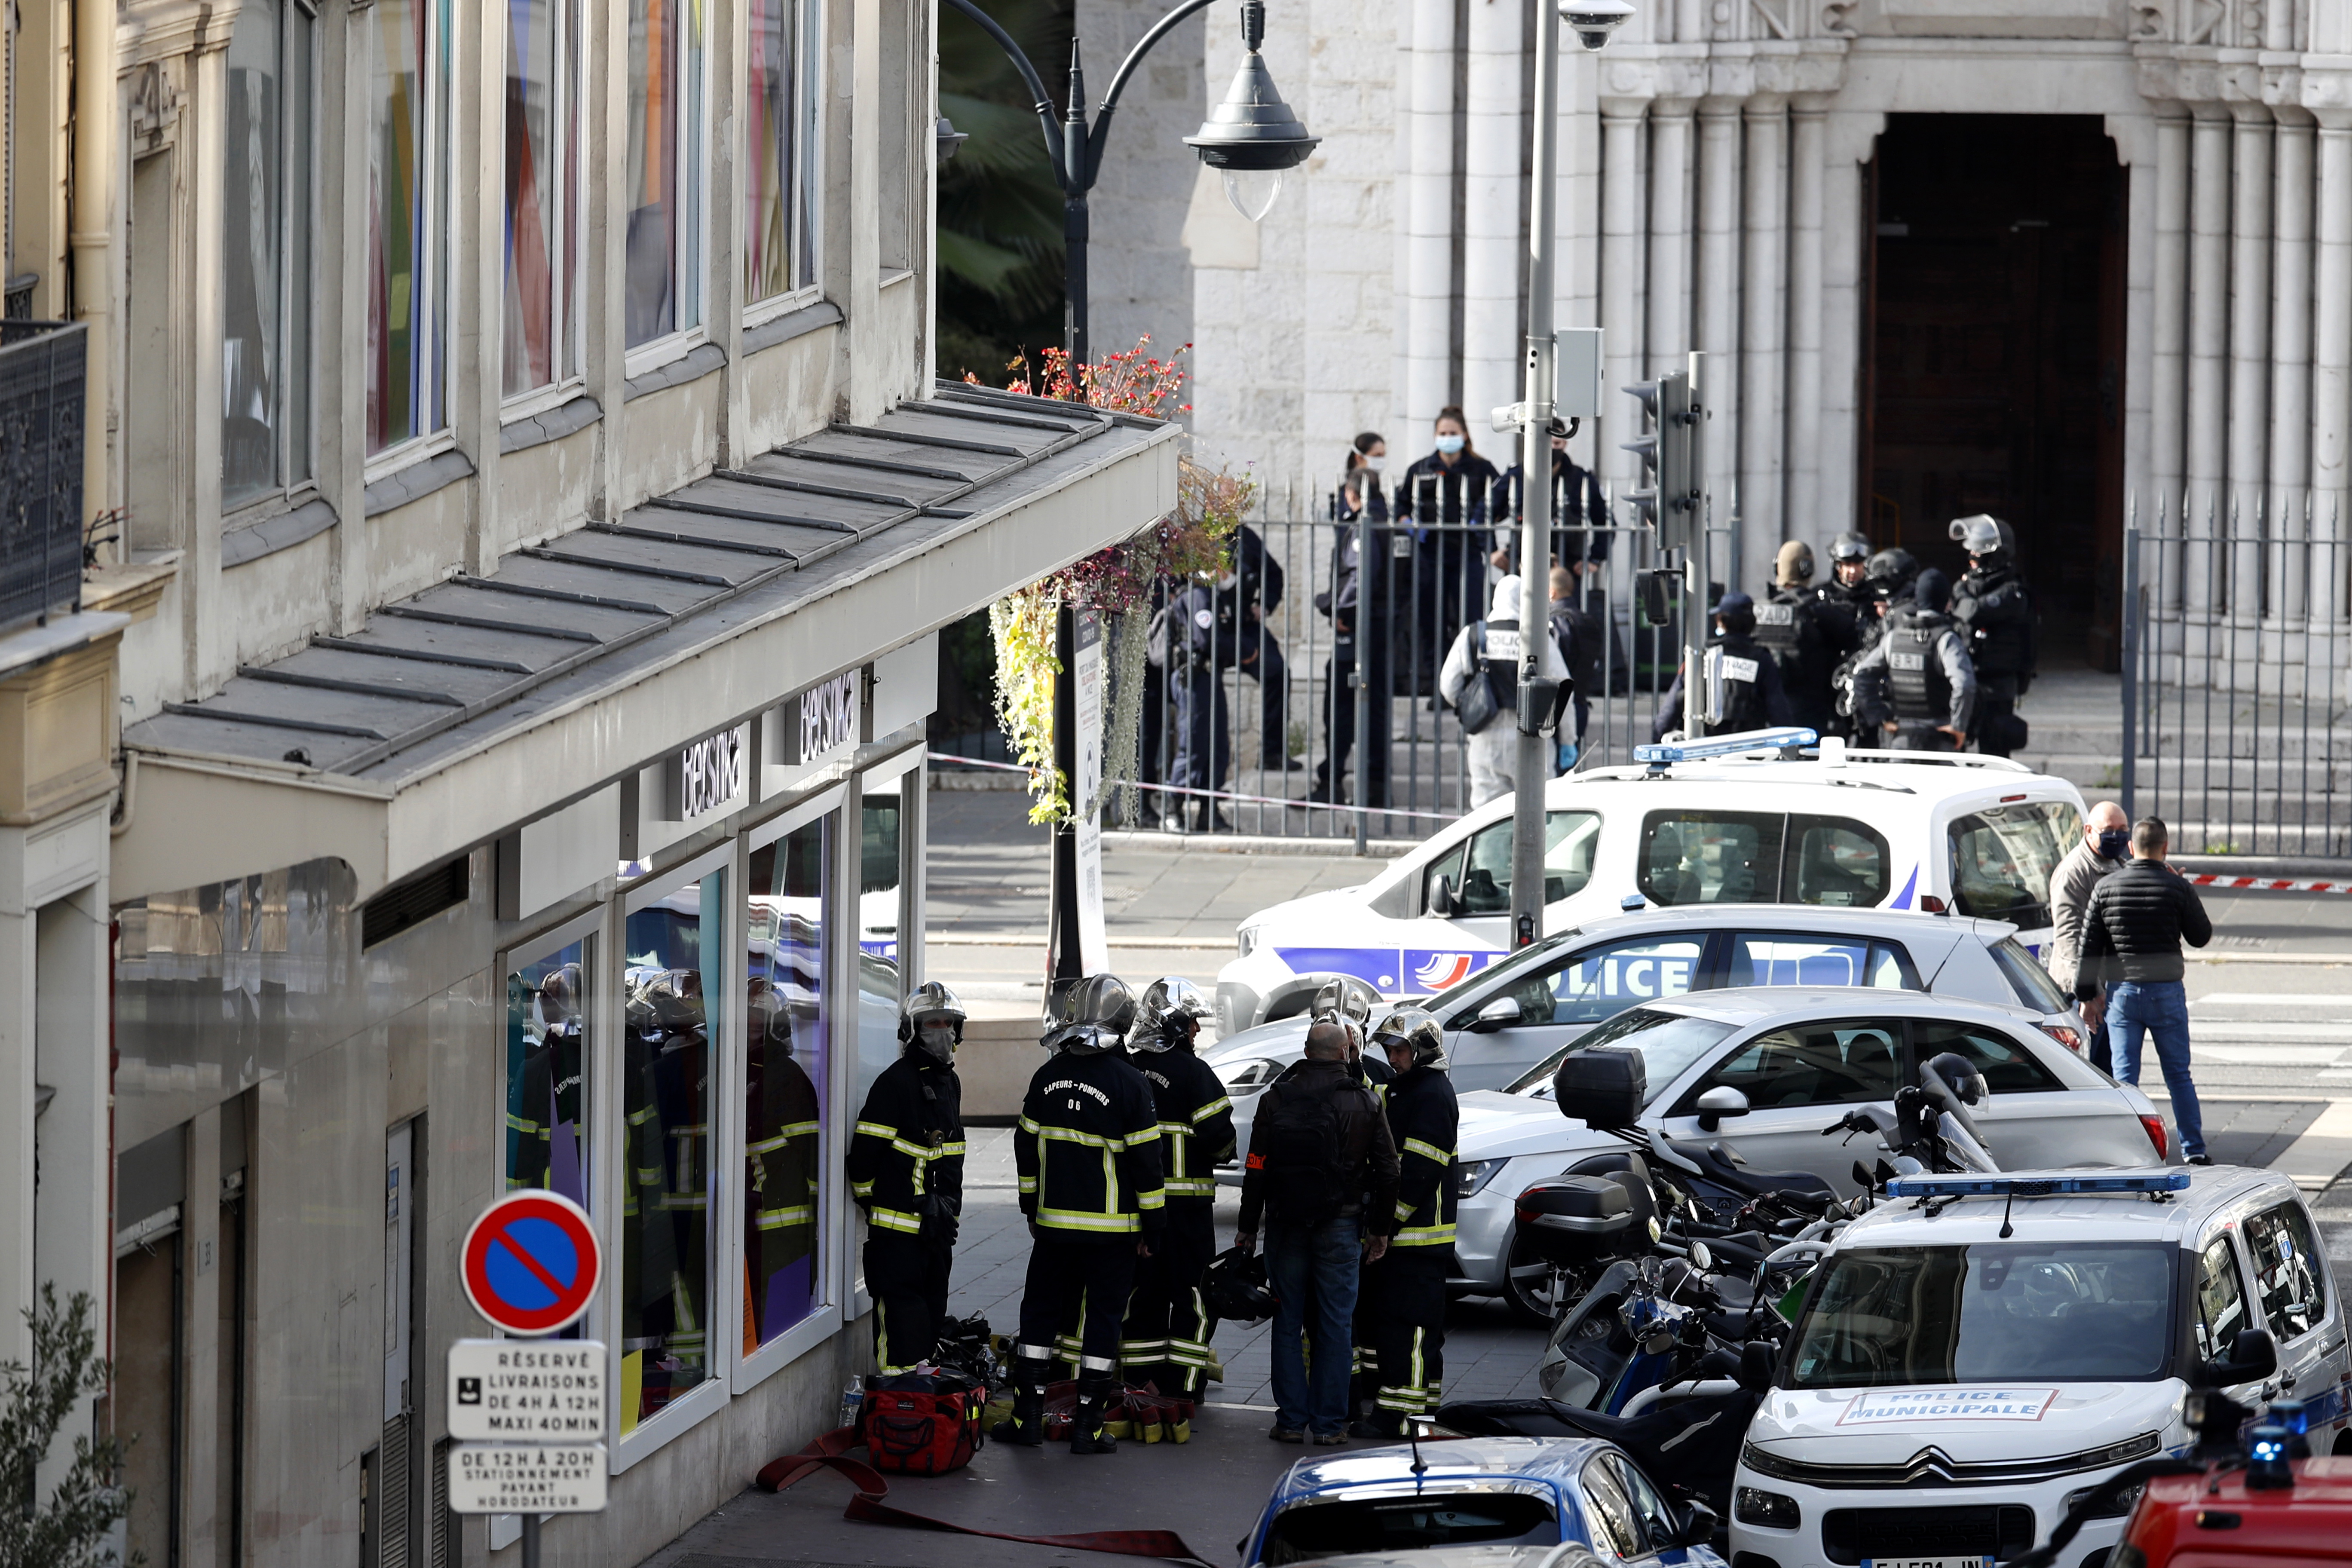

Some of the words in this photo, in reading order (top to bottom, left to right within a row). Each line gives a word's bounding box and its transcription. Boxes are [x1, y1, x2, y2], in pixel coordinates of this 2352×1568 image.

[498, 1351, 588, 1368] RÉSERVÉ
[489, 1375, 598, 1389] LIVRAISONS
[489, 1395, 509, 1409] DE
[549, 1393, 559, 1409] À
[1890, 1392, 2014, 1403] POLICE
[1847, 1404, 2039, 1419] MUNICIPALE
[489, 1416, 533, 1430] MAXI
[462, 1452, 484, 1467] DE
[537, 1449, 546, 1465] À
[465, 1469, 591, 1479] STATIONNEMENT
[501, 1483, 554, 1492] PAYANT
[478, 1496, 579, 1507] HORODATEUR
